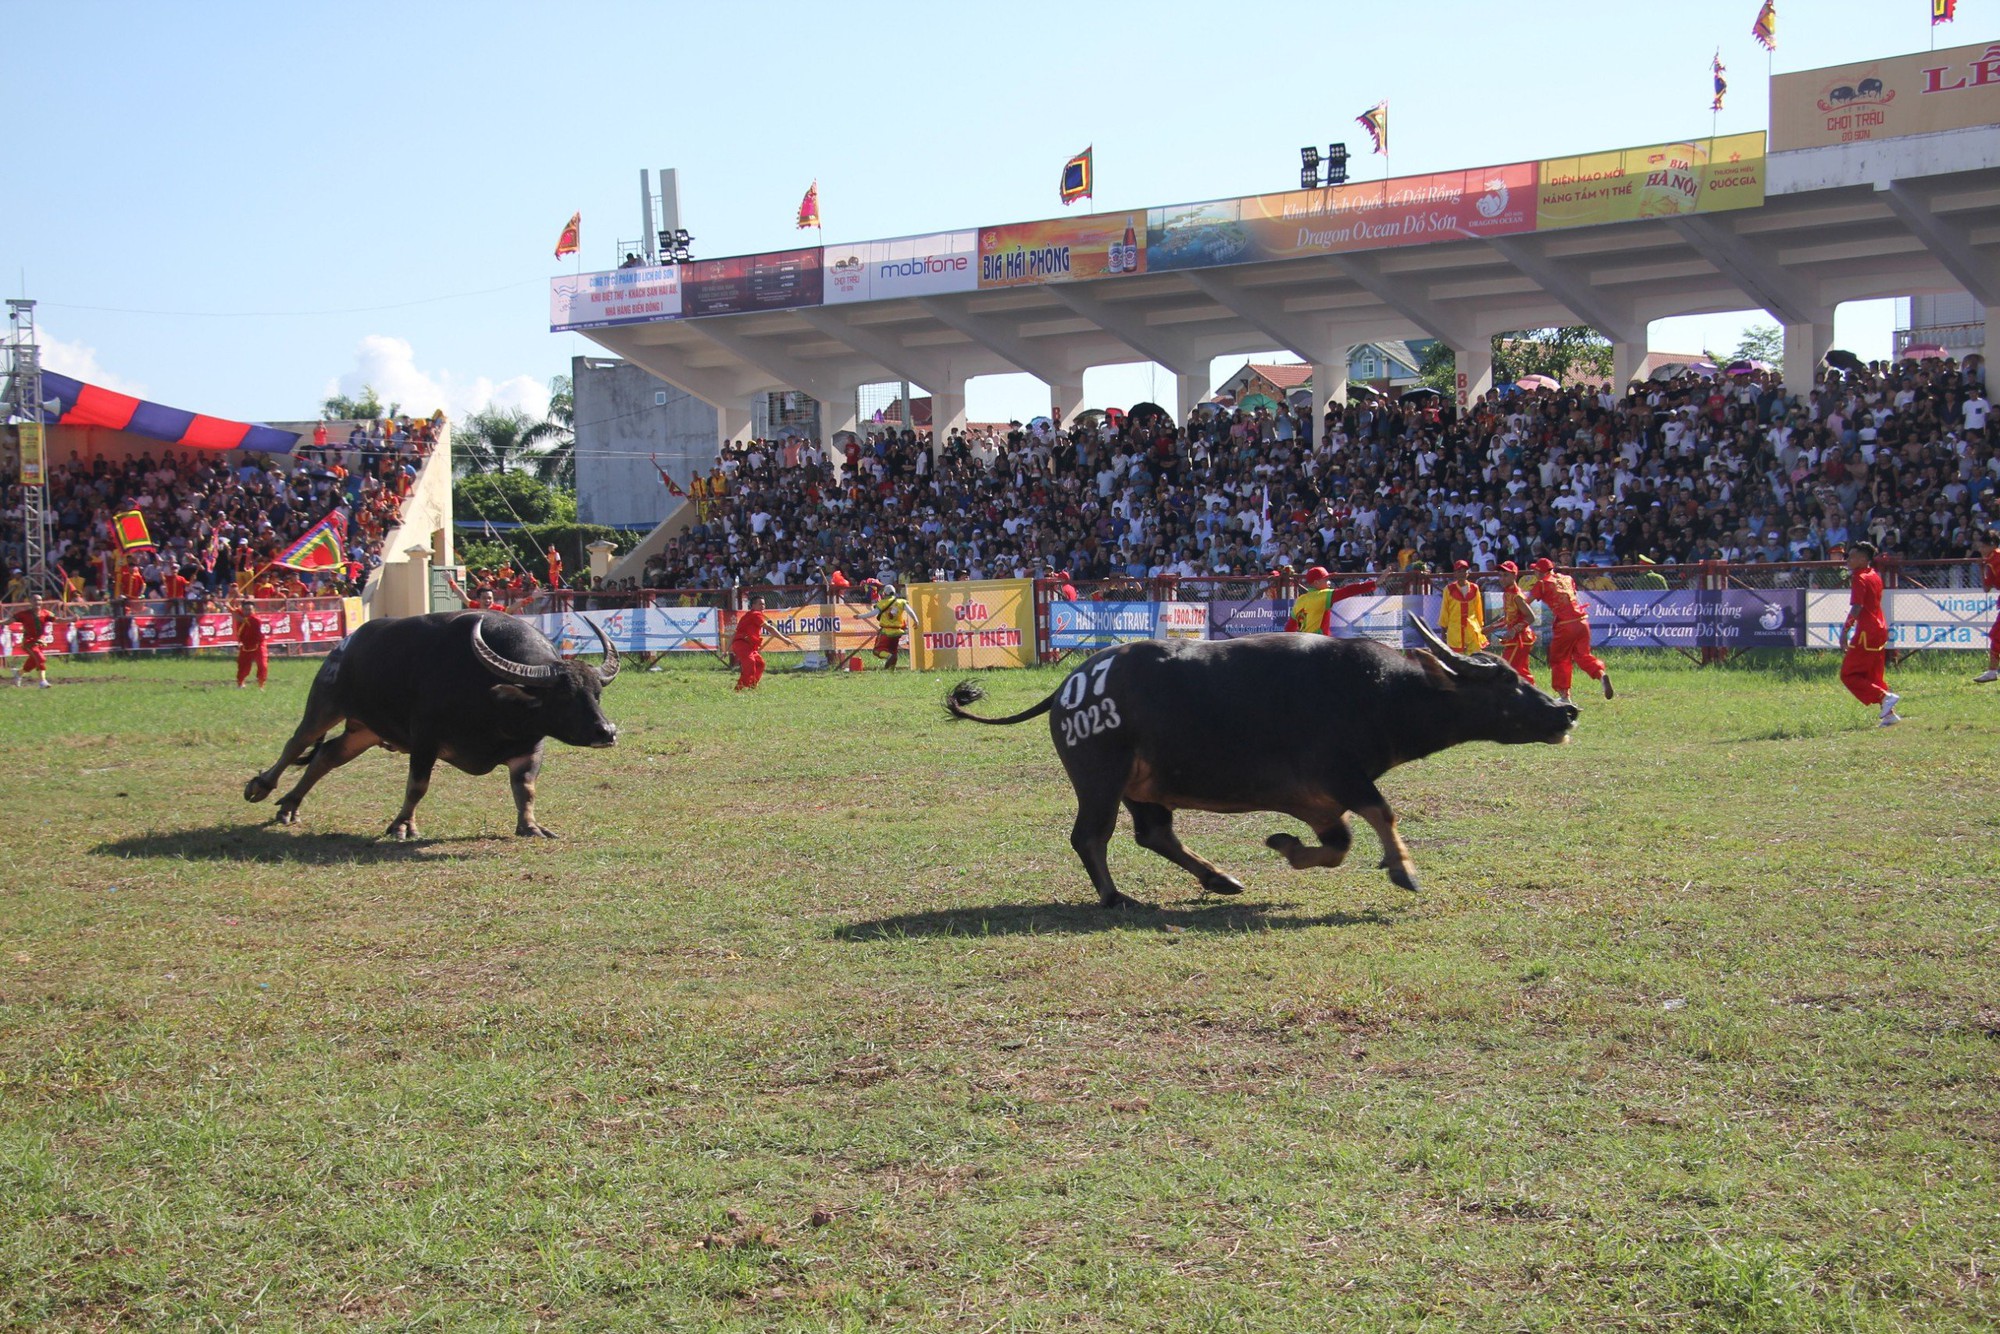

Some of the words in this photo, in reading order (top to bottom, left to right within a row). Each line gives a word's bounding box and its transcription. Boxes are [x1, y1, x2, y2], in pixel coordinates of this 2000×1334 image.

[1855, 109, 1884, 126] TRÂU
[1670, 159, 1688, 172] BIA
[1714, 168, 1739, 176] THƯƠNG
[1740, 166, 1755, 174] HIỆU
[1551, 174, 1575, 188] DIỆN
[1578, 172, 1601, 184] MẠO
[1604, 167, 1625, 179] MỚI
[1646, 169, 1669, 187] HÀ
[1671, 174, 1698, 198] NỘI
[1709, 177, 1739, 191] QUỐC
[1740, 175, 1757, 186] GIA
[1599, 188, 1609, 200] VỊ
[1612, 180, 1633, 196] THẾ
[1283, 203, 1307, 220] Khu
[1309, 200, 1325, 217] du
[1327, 196, 1350, 219] lịch
[1351, 191, 1385, 214] Quốc
[1388, 189, 1402, 208] tế
[1402, 186, 1427, 206] Đồi
[1427, 184, 1463, 205] Rồng
[1297, 227, 1350, 249] Dragon
[1353, 221, 1400, 239] Ocean
[1403, 211, 1426, 234] Đồ
[1427, 211, 1457, 232] Sơn
[881, 255, 968, 278] mobifone
[983, 254, 1003, 280] BIA
[1006, 245, 1026, 280] HẢI
[1029, 243, 1070, 277] PHÒNG
[955, 599, 988, 621] CỬA
[1075, 605, 1091, 630] HẢI
[1091, 608, 1122, 631] PHÒNG
[1123, 611, 1154, 631] TRAVEL
[1230, 608, 1256, 619] Dream
[1257, 607, 1287, 620] Dragon
[1595, 604, 1616, 617] Khu
[1617, 604, 1631, 617] du
[1632, 603, 1651, 619] lịch
[1652, 602, 1681, 619] Quốc
[1682, 602, 1694, 616] tế
[1694, 601, 1713, 616] Đồi
[1714, 602, 1742, 619] Rồng
[777, 615, 797, 634] HẢI
[800, 615, 841, 634] PHÒNG
[1608, 623, 1652, 640] Dragon
[1654, 623, 1693, 638] Ocean
[1695, 621, 1714, 637] Đồ
[1715, 623, 1740, 637] Sơn
[1916, 624, 1971, 642] Data
[923, 629, 975, 650] THOÁT
[979, 623, 1022, 647] HIỂM
[1060, 654, 1117, 710] 07
[1061, 697, 1121, 747] 2023
